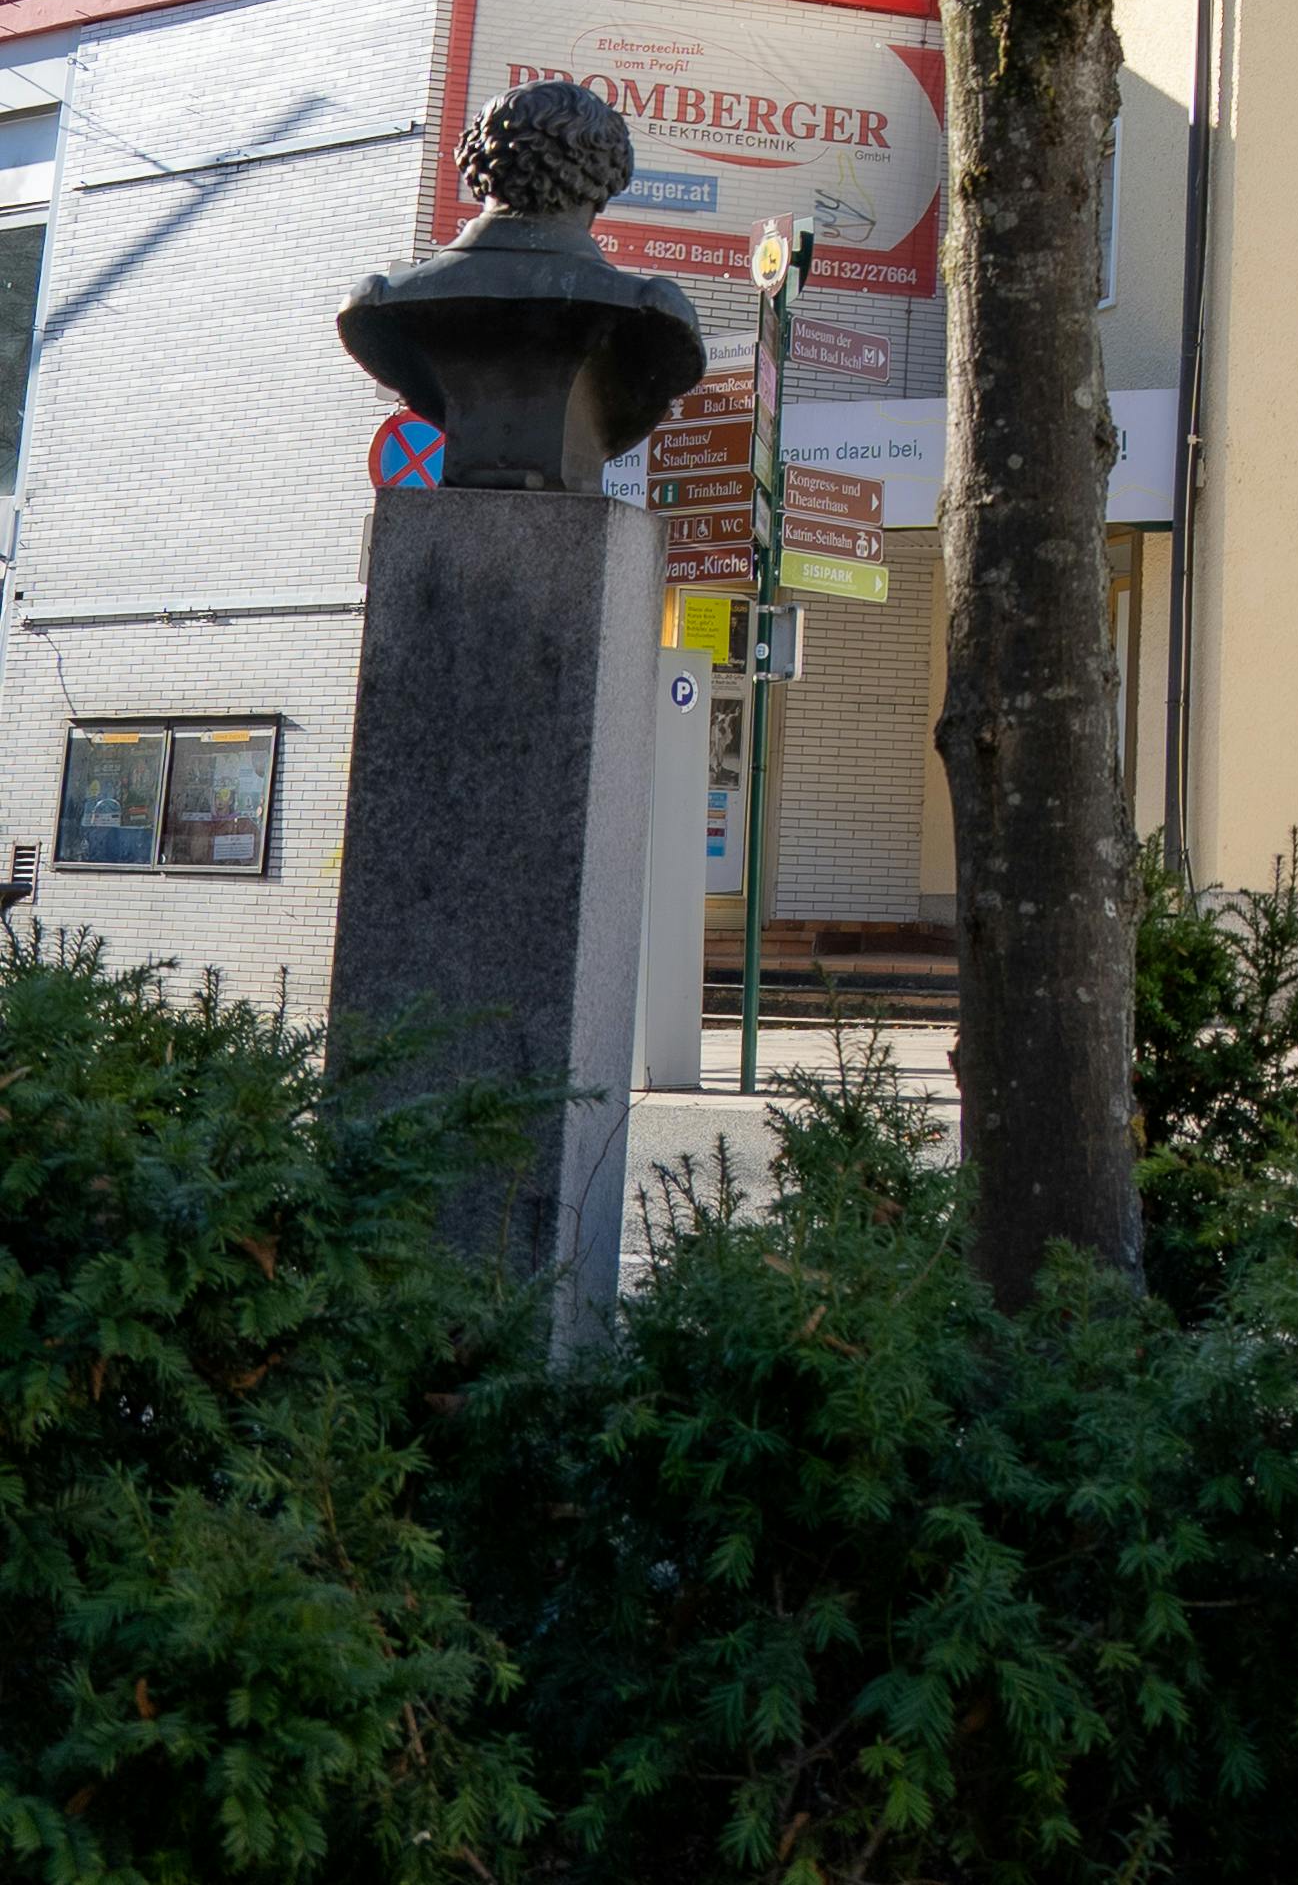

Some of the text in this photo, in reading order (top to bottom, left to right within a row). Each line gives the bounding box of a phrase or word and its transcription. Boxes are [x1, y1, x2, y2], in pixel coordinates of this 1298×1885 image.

[597, 37, 704, 58] Elektrotechnik
[614, 58, 689, 76] vom Profi!
[648, 122, 797, 153] ELEKTROTECHNIK
[854, 149, 892, 163] GmbH
[644, 240, 686, 260] 4820
[691, 245, 723, 265] Bad
[810, 260, 918, 285] 06132/27664
[796, 322, 852, 348] Museum der
[795, 341, 862, 371] Stadt Bad Ischl
[704, 397, 726, 414] Bad
[663, 429, 712, 449] Rathaus/
[836, 441, 881, 460] dazu
[888, 439, 922, 460] bei,
[663, 447, 728, 468] Stadtpolizei
[686, 480, 743, 499] Trinkhalle
[789, 470, 861, 497] Kongress- und
[787, 490, 849, 514] Theaterhaus
[721, 517, 744, 533] WC
[785, 524, 853, 549] Katrin-Seilbahn
[803, 563, 853, 584] SISIPARK
[676, 680, 692, 702] P
